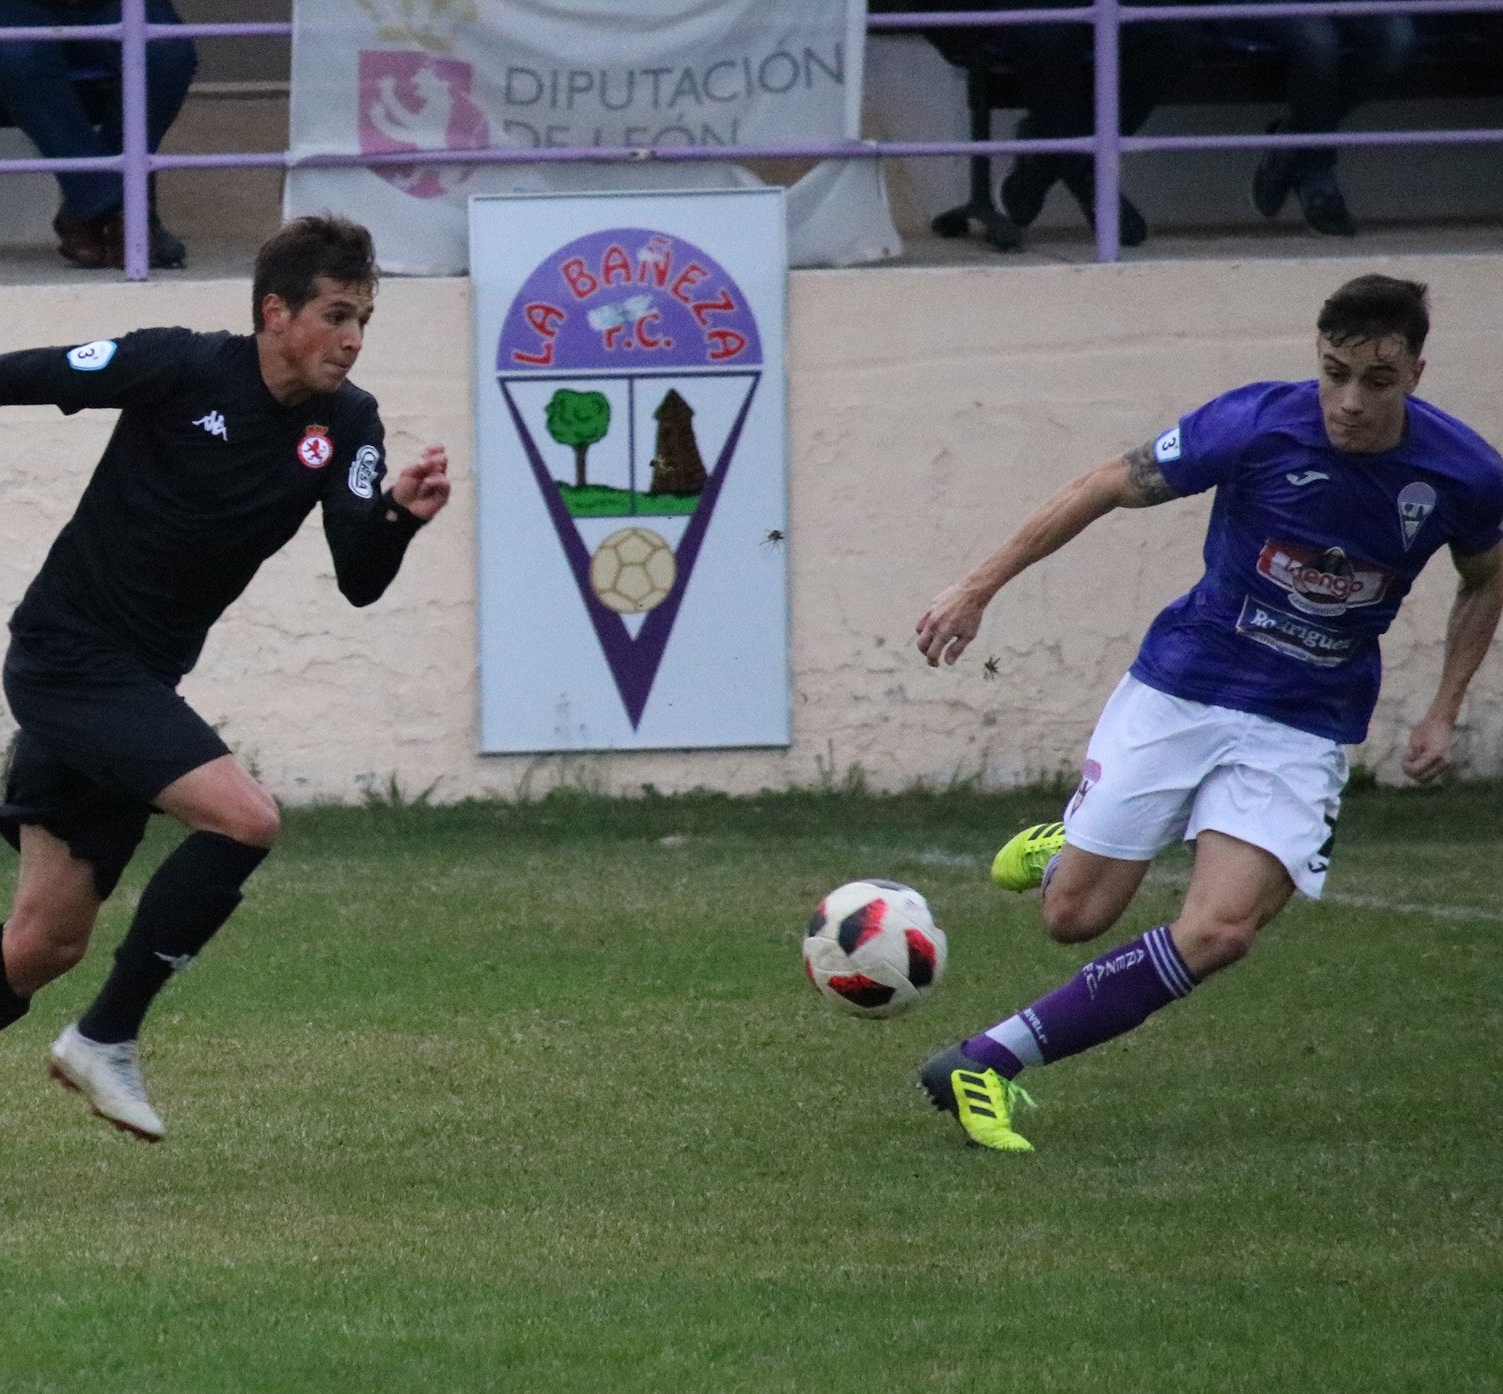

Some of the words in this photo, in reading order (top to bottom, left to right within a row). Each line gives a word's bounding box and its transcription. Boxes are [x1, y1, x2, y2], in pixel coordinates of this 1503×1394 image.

[503, 37, 845, 111] DIPUTACIÓN
[503, 119, 570, 149] DE
[512, 303, 565, 365] LA
[561, 236, 747, 361] BAÑEZA
